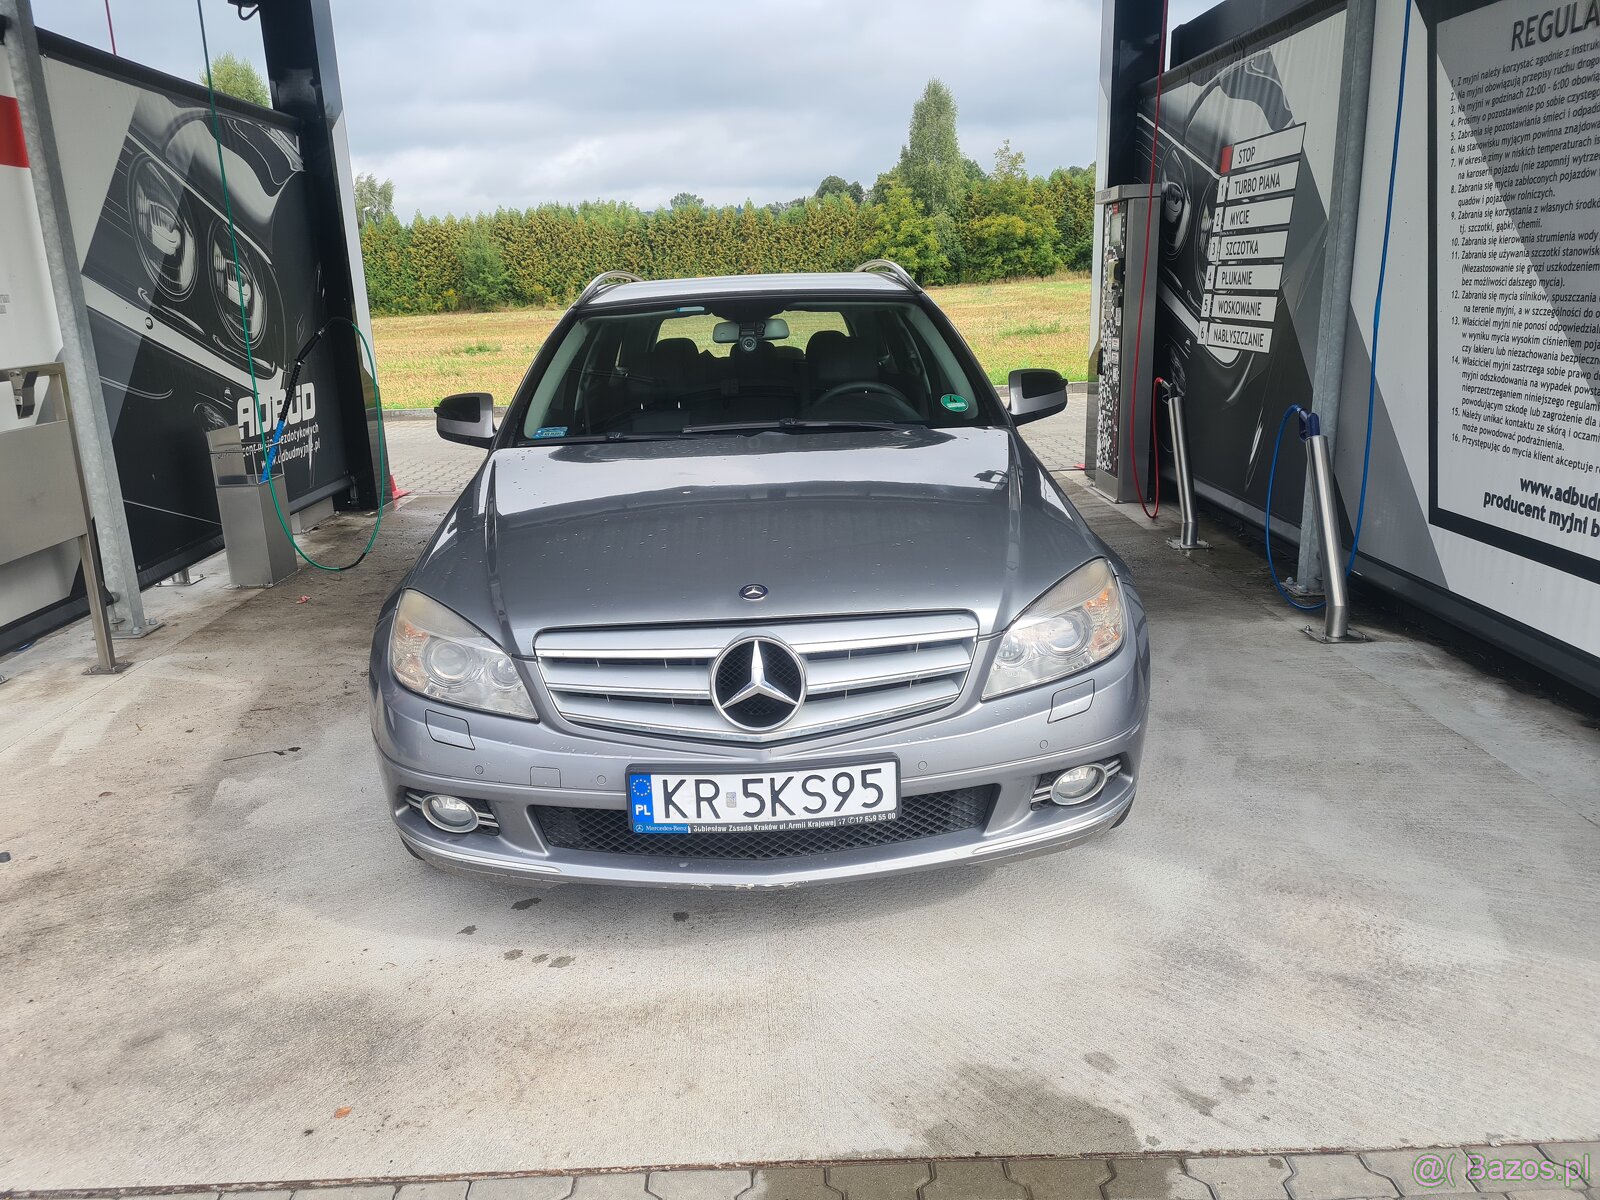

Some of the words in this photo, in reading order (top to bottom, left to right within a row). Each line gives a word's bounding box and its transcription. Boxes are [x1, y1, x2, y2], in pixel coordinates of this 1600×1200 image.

[1238, 146, 1256, 164] STOP
[1235, 177, 1257, 195] TURBO
[1259, 172, 1280, 191] PIANA
[1216, 213, 1220, 226] 2
[1230, 210, 1250, 226] MYCIE
[1212, 242, 1216, 255] 3
[1226, 240, 1259, 256] SZCZOTKA
[1208, 272, 1212, 284] 4
[1204, 299, 1208, 312] 5
[1218, 300, 1262, 316] WOSKOWANIE
[1201, 327, 1204, 339] 6
[1483, 492, 1546, 521] producent
[1548, 510, 1588, 534] myjni
[662, 778, 722, 819] KR
[741, 768, 884, 818] 5KS95
[635, 804, 651, 816] PL
[754, 823, 777, 831] Kraków
[808, 819, 836, 828] Krajowej
